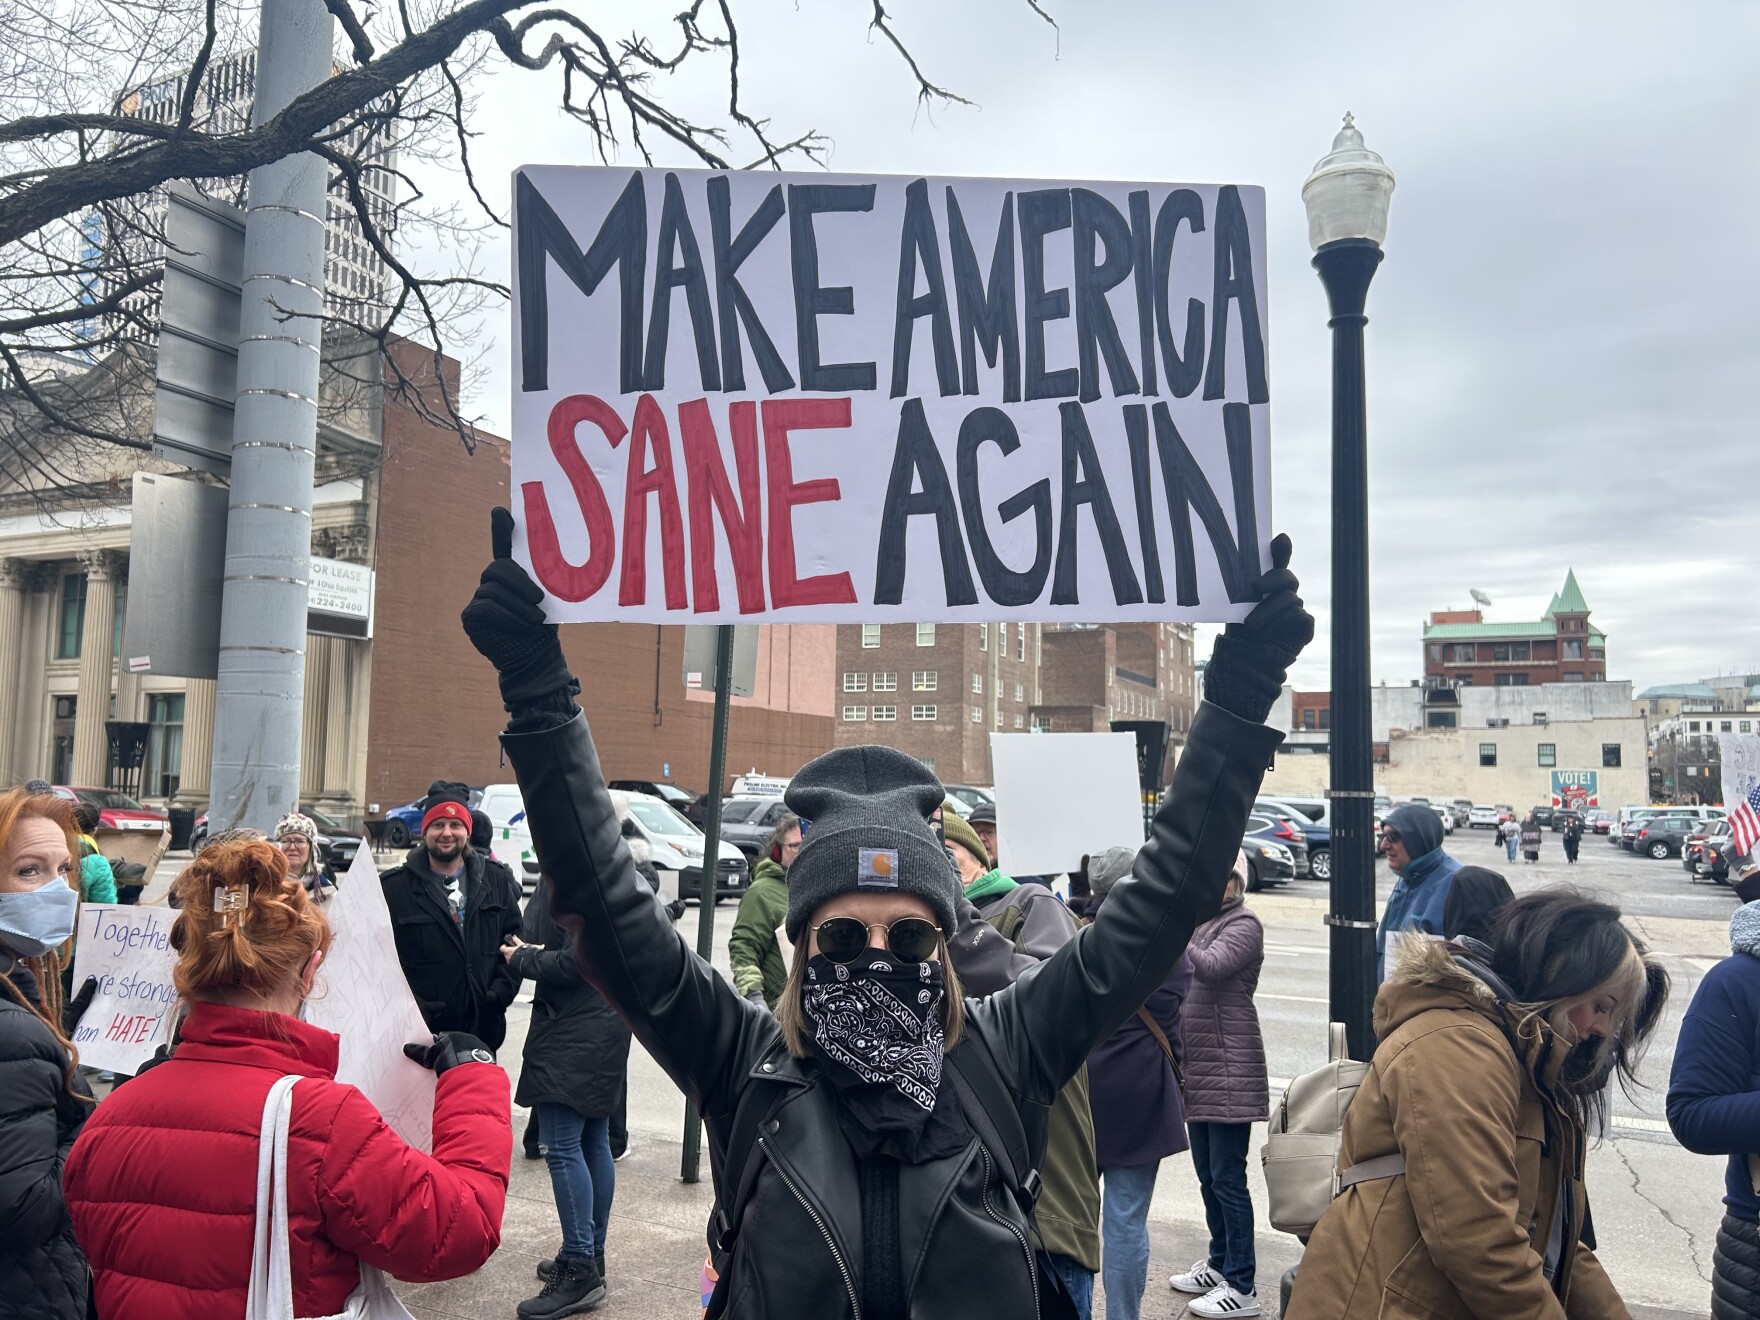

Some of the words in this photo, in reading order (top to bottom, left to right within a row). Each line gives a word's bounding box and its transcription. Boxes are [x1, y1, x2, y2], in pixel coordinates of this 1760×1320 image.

[516, 170, 877, 394] MAKE
[890, 177, 1269, 404] AMERICA
[521, 393, 858, 615] SANE
[873, 396, 1261, 607] AGAIN
[331, 567, 362, 581] LEASE
[316, 597, 362, 612] 224-2400
[1557, 771, 1591, 785] VOTE!
